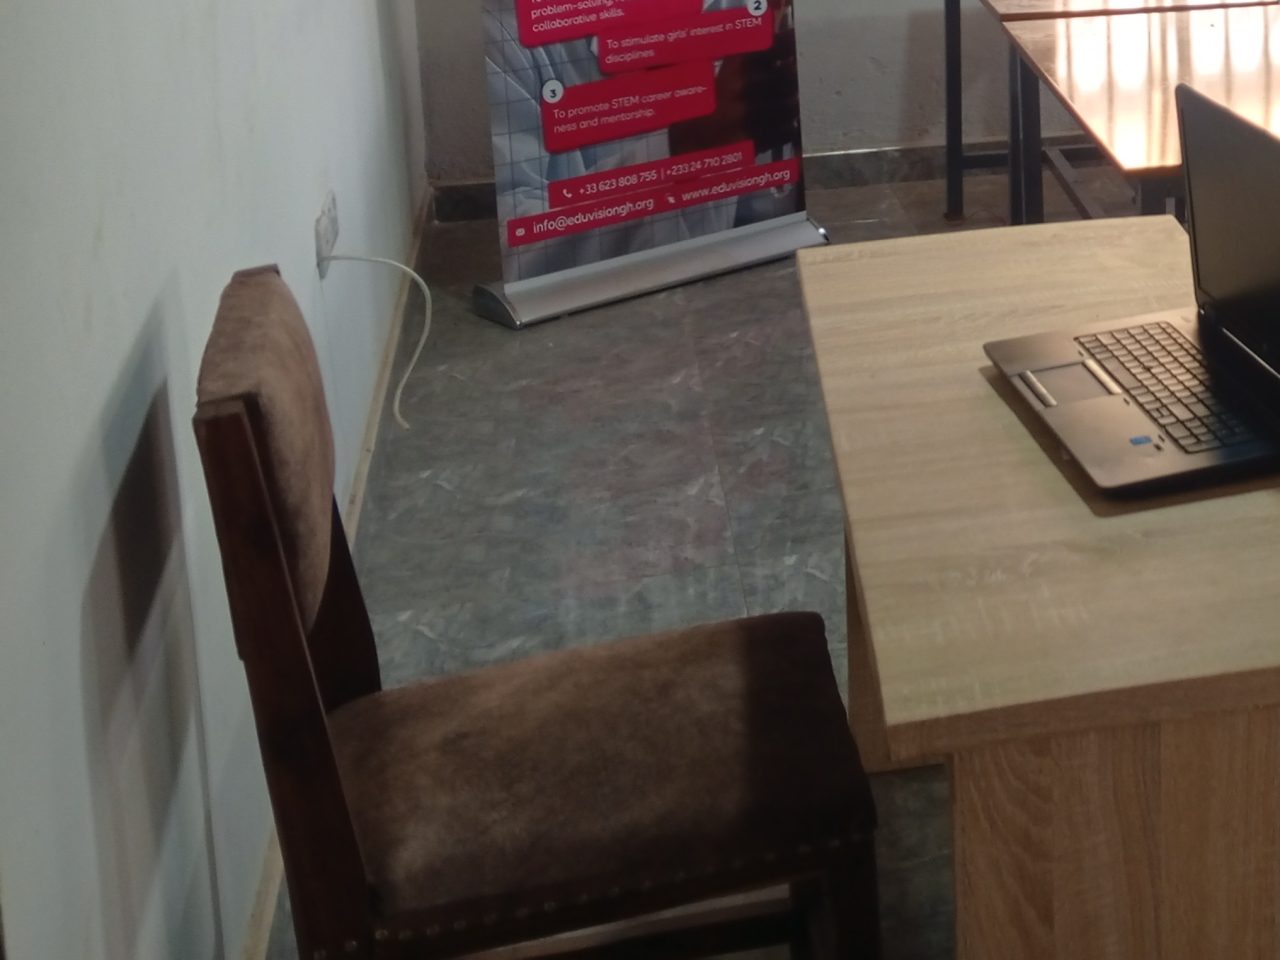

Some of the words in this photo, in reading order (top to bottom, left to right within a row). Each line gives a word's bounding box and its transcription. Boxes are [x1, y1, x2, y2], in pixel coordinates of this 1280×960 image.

[753, 0, 763, 11] 2
[532, 13, 598, 32] collaborative
[607, 39, 619, 49] To
[620, 32, 666, 48] stimulate
[690, 23, 724, 37] interest
[735, 17, 763, 30] STEM
[549, 88, 557, 99] 3
[553, 108, 566, 119] To
[568, 102, 610, 119] promote
[611, 95, 640, 110] STEM
[641, 90, 673, 103] career
[553, 121, 577, 134] ness
[579, 117, 599, 129] and
[532, 198, 655, 234] info@eduvisiongh.org
[681, 170, 791, 202] www.eduvisiongh.org
